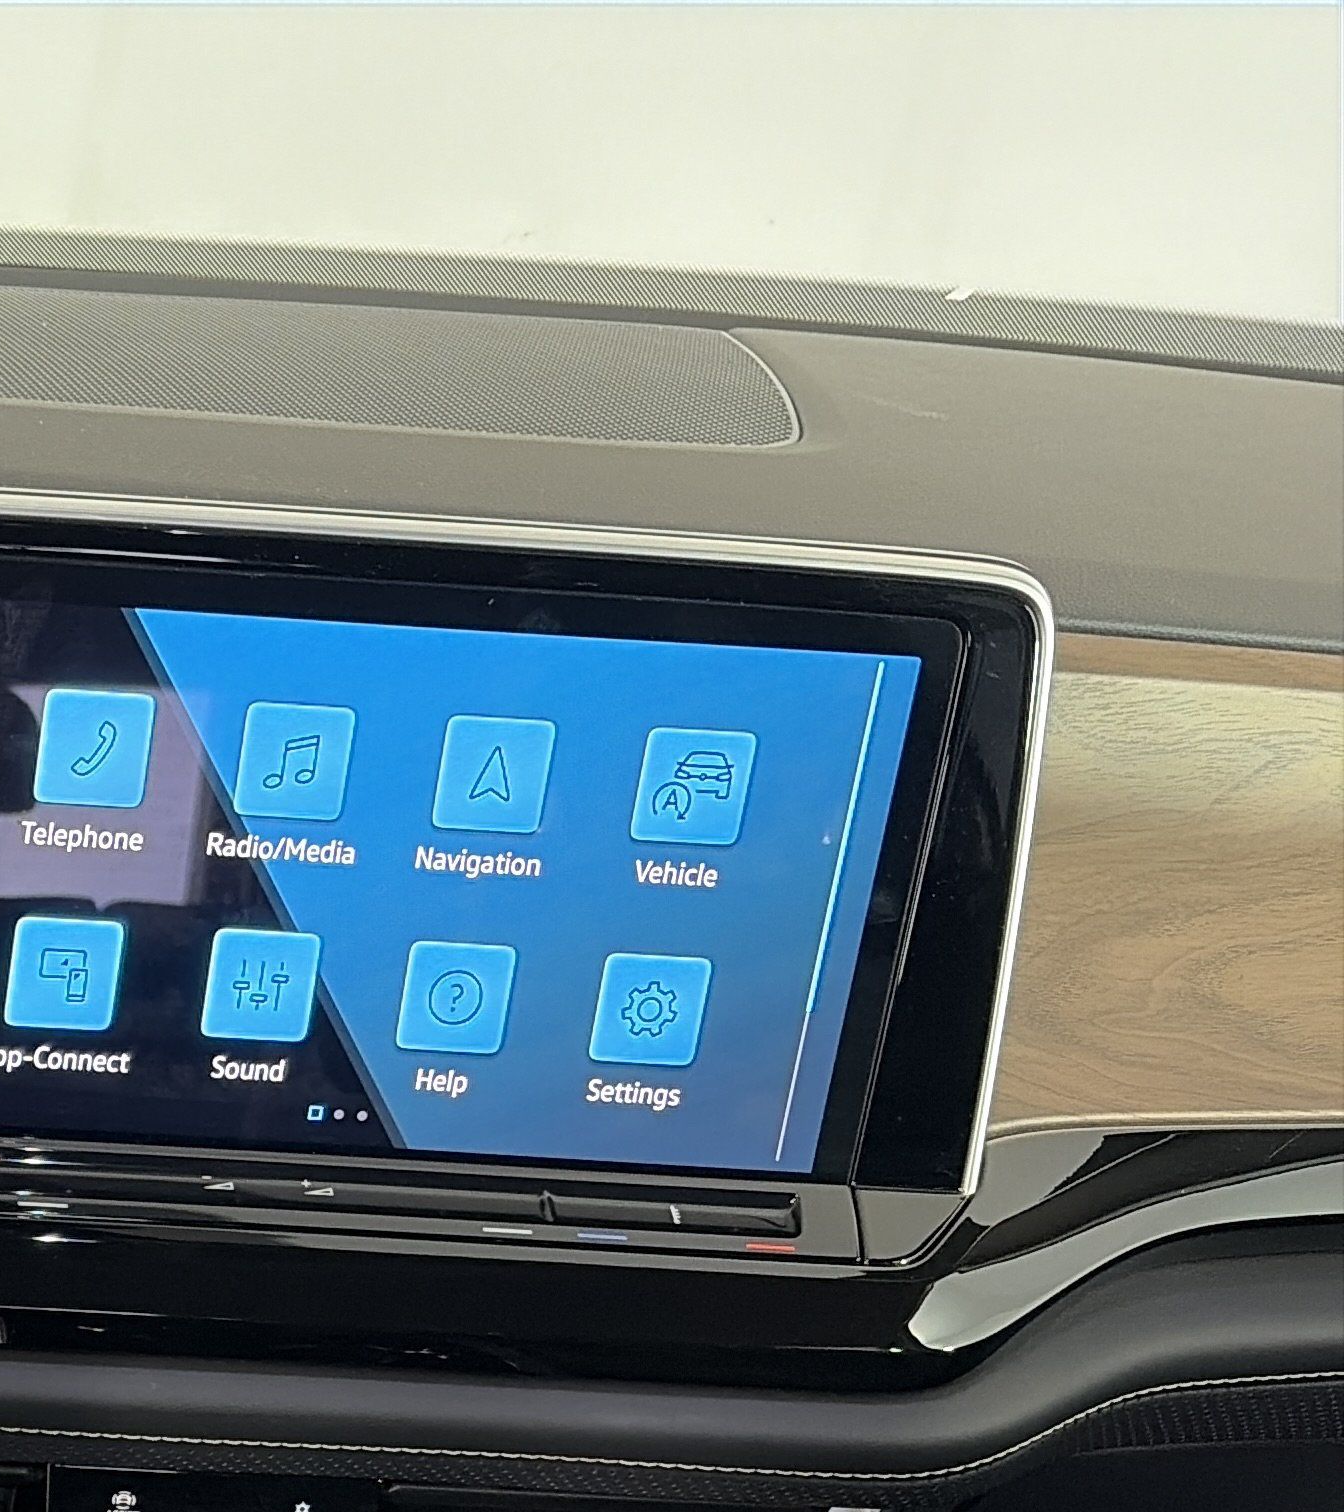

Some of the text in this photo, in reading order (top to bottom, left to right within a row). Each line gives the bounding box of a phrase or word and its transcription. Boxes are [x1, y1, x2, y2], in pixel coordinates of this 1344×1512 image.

[21, 820, 144, 852] Telephone
[206, 833, 356, 865] Radio/Media
[414, 845, 541, 878] Navigation
[635, 859, 718, 888] Vehicle
[211, 1056, 285, 1083] Sound
[415, 1068, 468, 1096] Help
[586, 1078, 681, 1109] Settings
